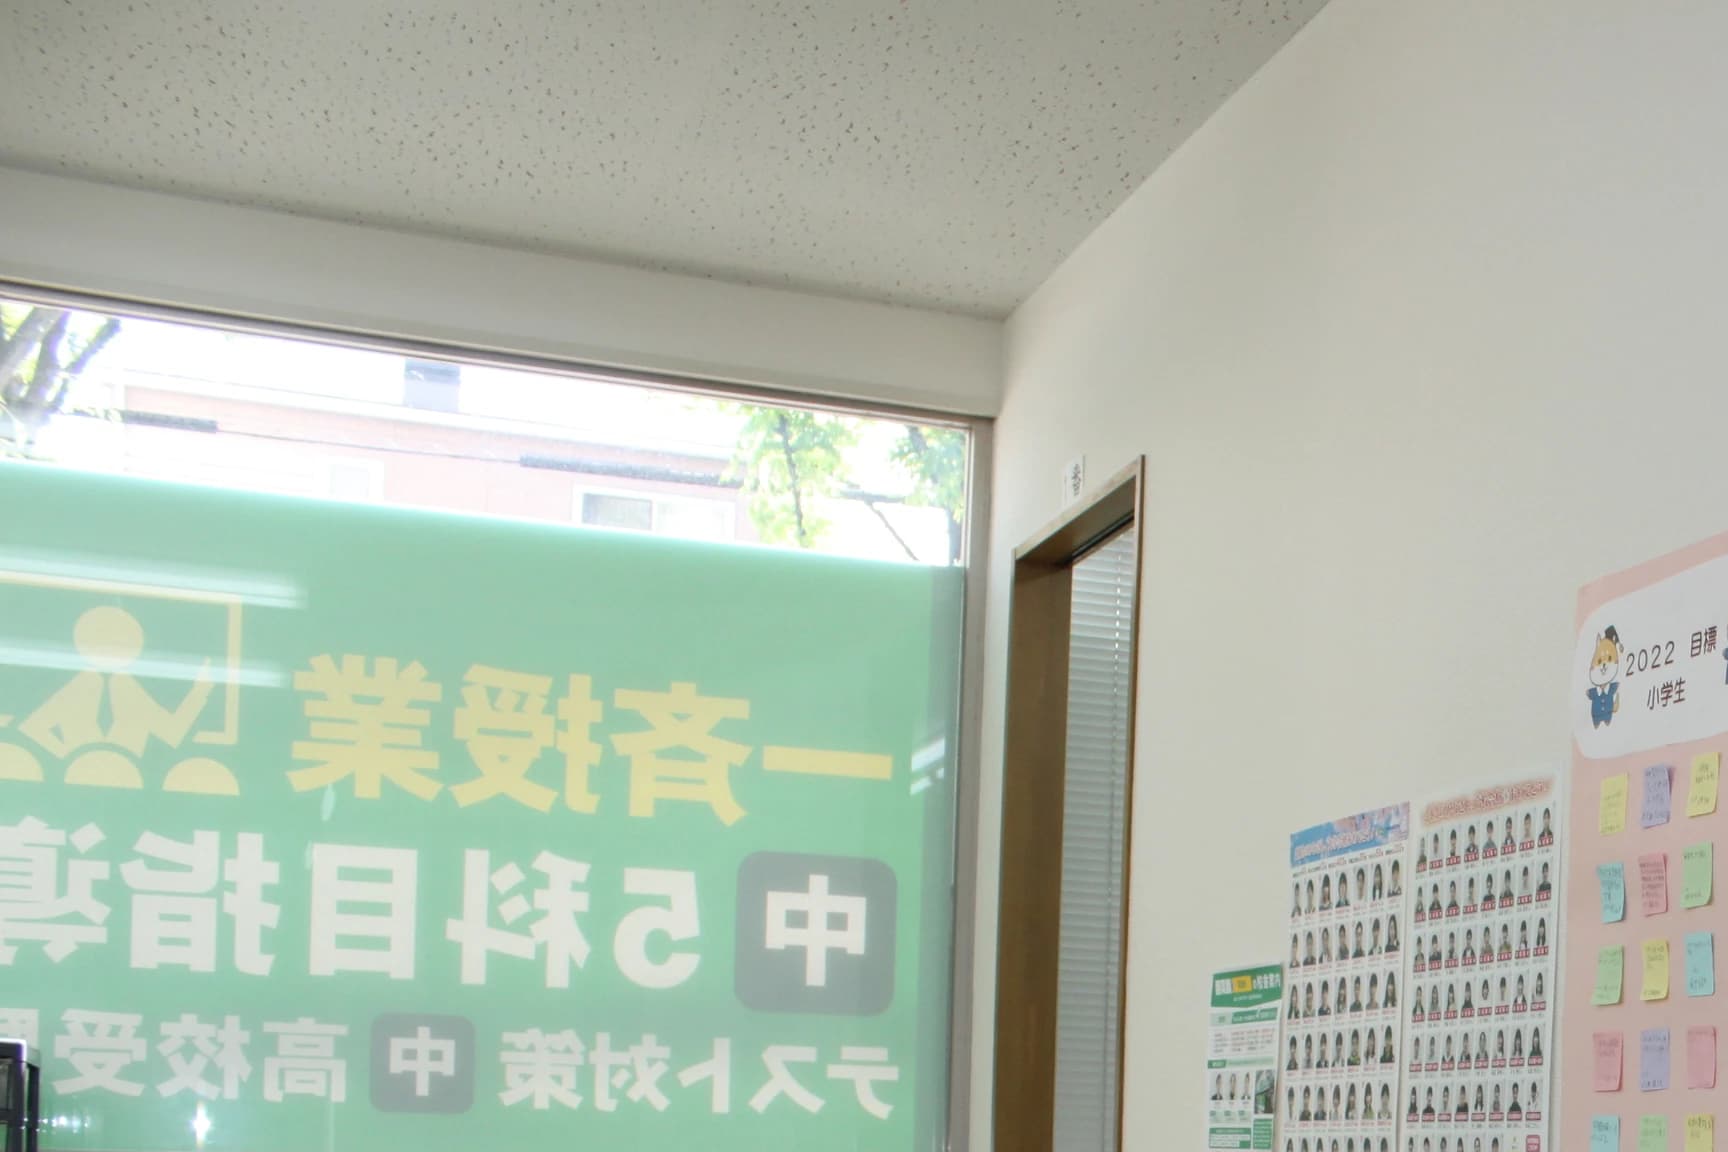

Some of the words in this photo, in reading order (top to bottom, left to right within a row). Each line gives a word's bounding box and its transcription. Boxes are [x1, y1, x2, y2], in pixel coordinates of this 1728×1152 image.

[1625, 641, 1675, 677] 2022
[1690, 625, 1717, 658] 目標
[1647, 676, 1686, 710] 小学生
